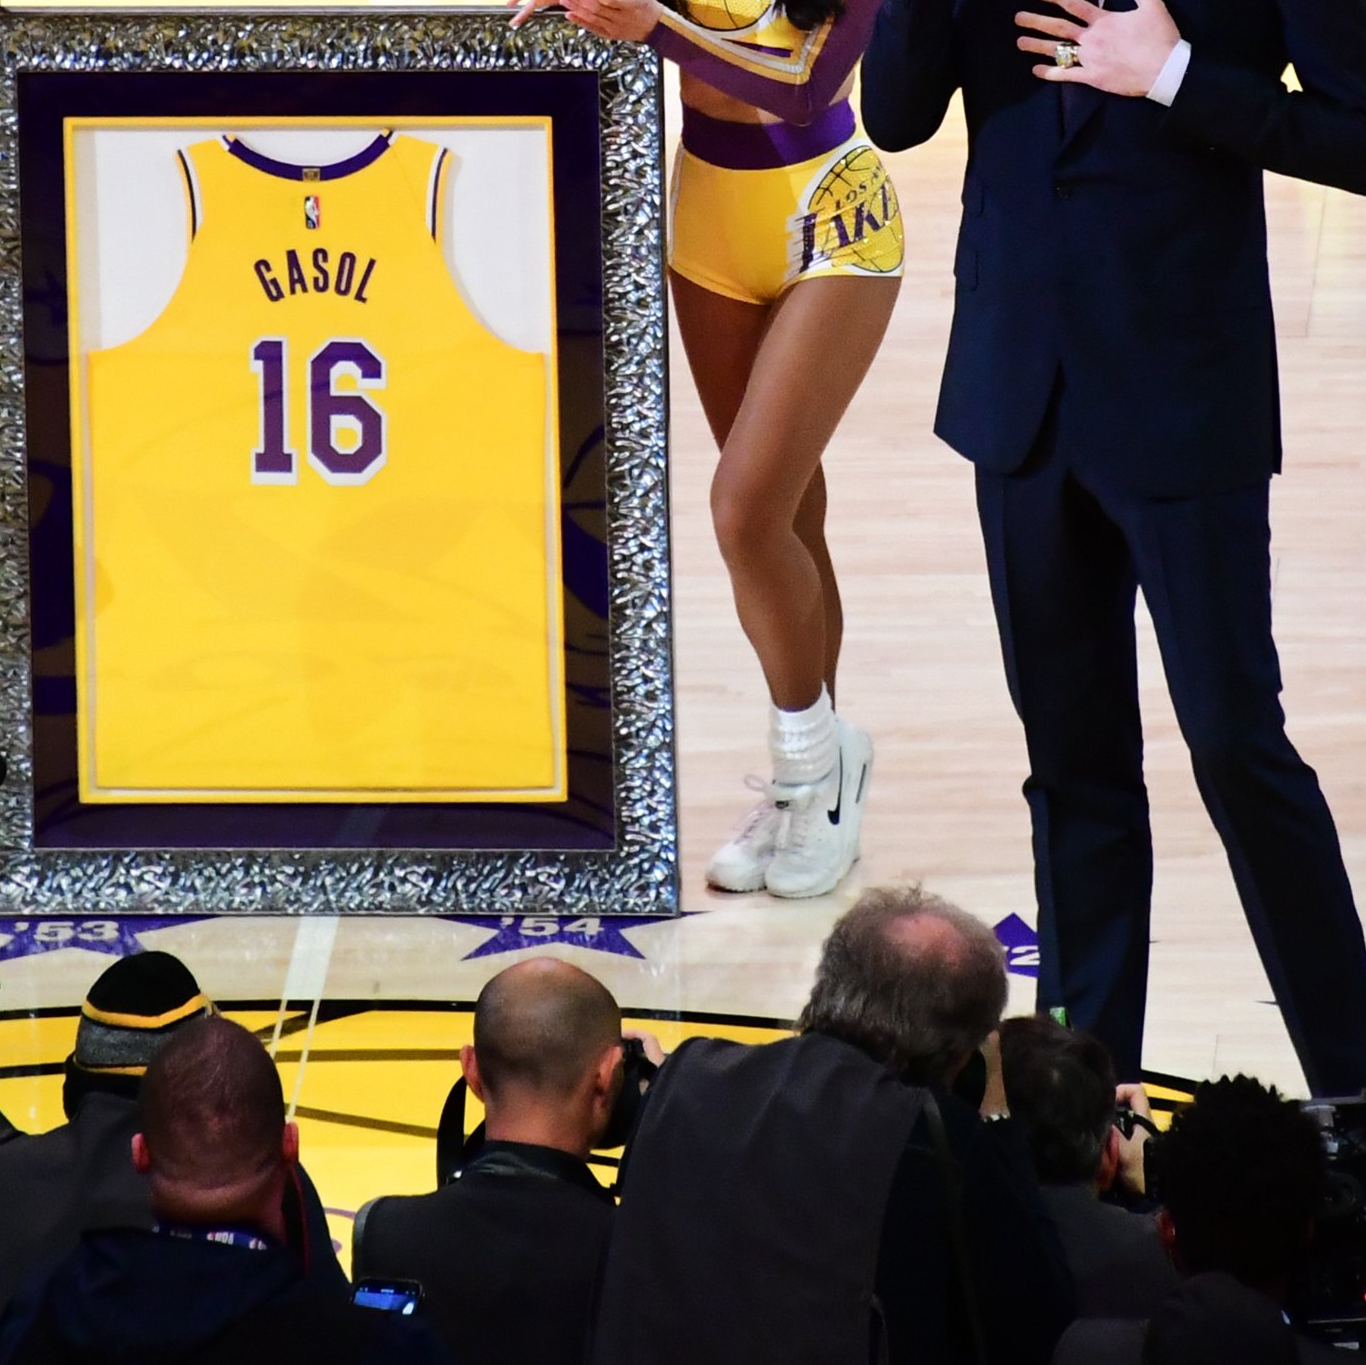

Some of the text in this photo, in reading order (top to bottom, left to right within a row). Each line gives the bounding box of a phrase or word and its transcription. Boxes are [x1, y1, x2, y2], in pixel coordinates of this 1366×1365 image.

[253, 247, 377, 304] GASOL
[249, 336, 388, 486] 16
[15, 920, 119, 943] '53
[500, 917, 605, 937] '54
